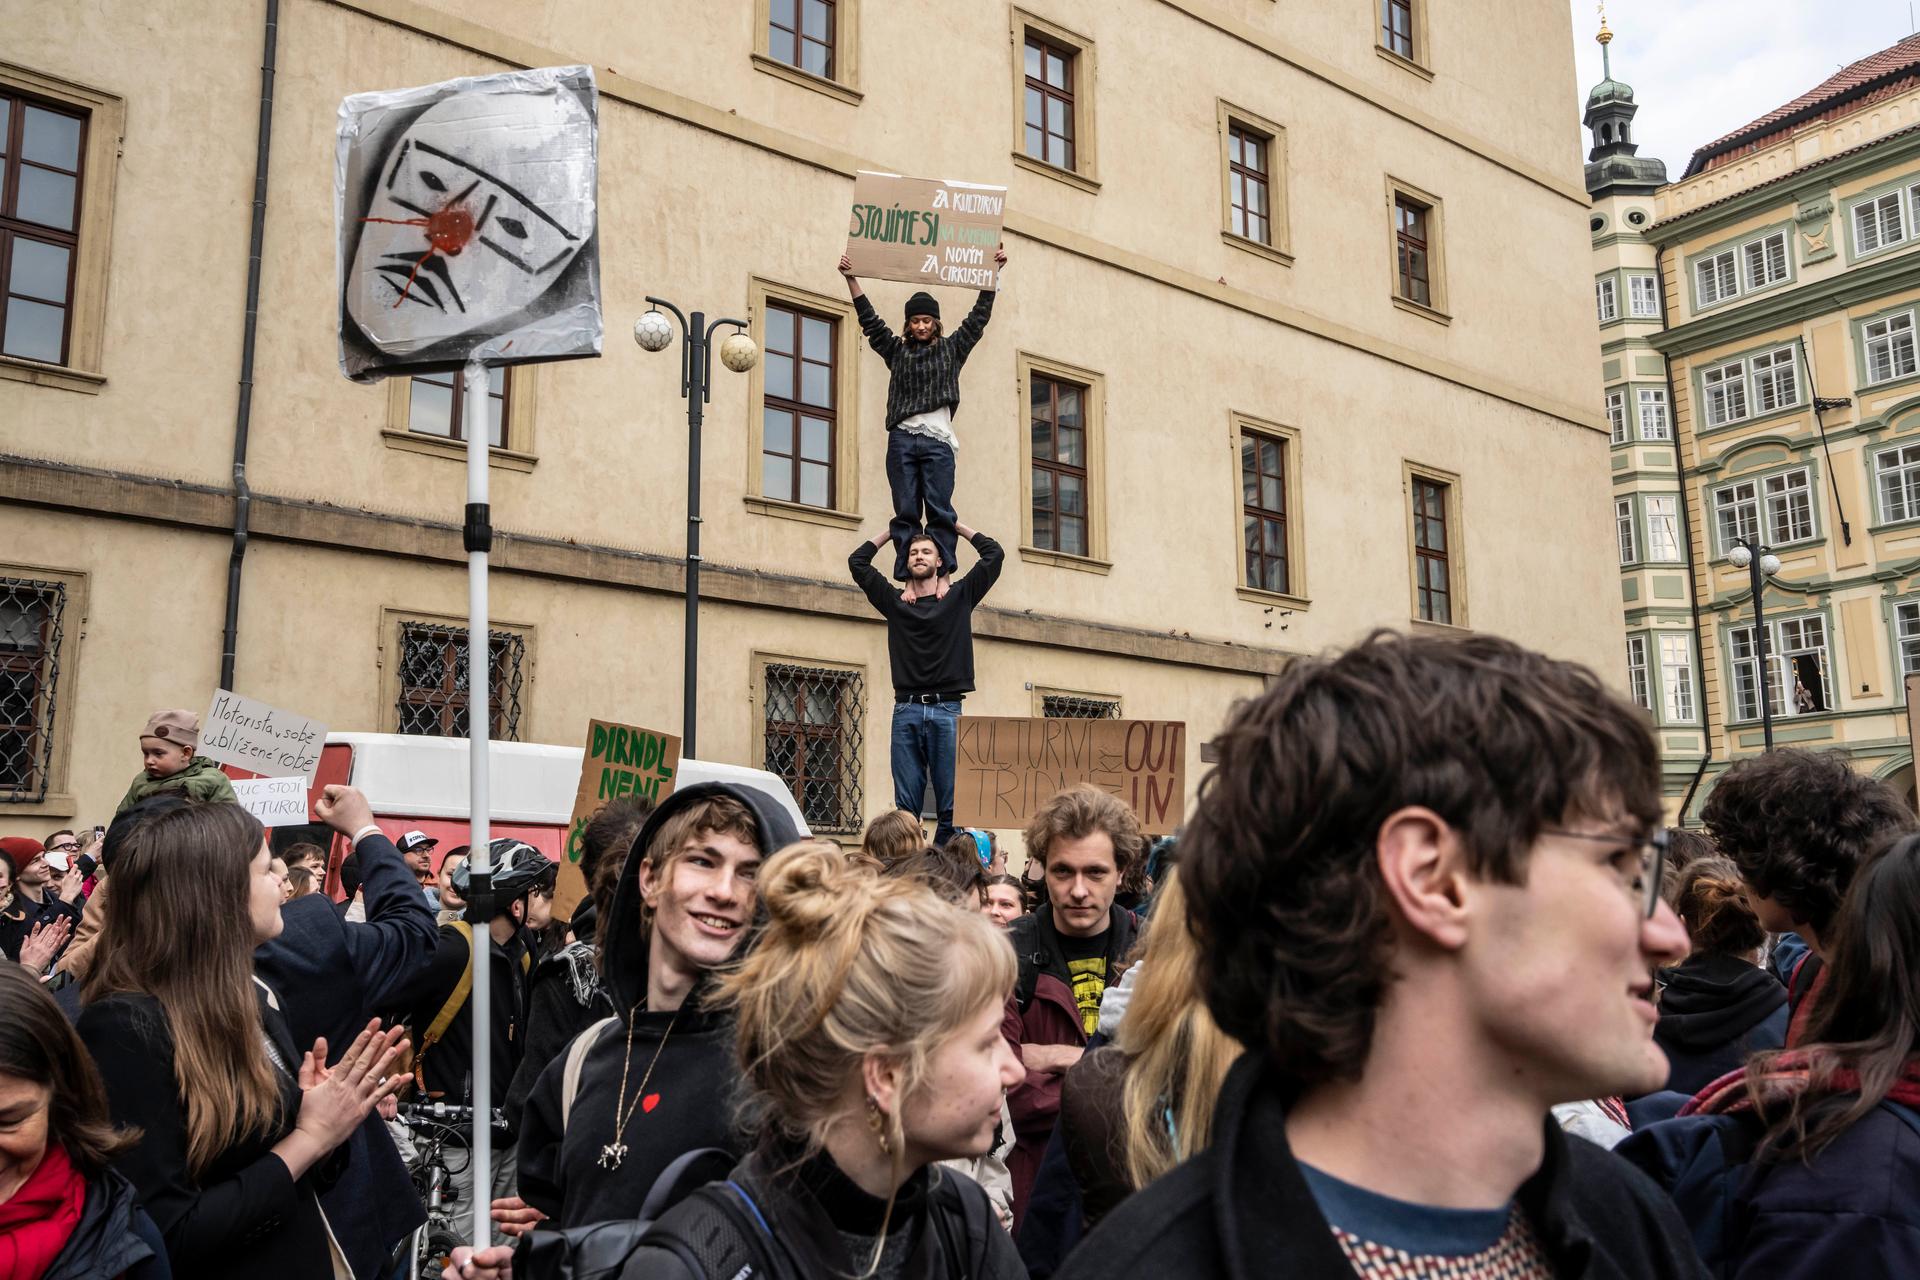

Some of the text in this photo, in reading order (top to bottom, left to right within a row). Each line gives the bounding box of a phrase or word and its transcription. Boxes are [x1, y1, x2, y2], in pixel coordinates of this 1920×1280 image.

[849, 203, 939, 247] STOJÍME SI
[932, 189, 1003, 216] ZA KULTUROU
[920, 254, 993, 287] ZA CIRKUSEM
[945, 245, 984, 265] NOVÝM
[213, 697, 273, 734] Motorista
[283, 720, 316, 744] sobě
[203, 725, 319, 772] ublížené robě
[591, 723, 673, 778] DIRNDL
[958, 719, 1186, 773] KULTURNÍ OUT
[268, 777, 305, 793] STOJÍ
[1131, 775, 1174, 824] IN
